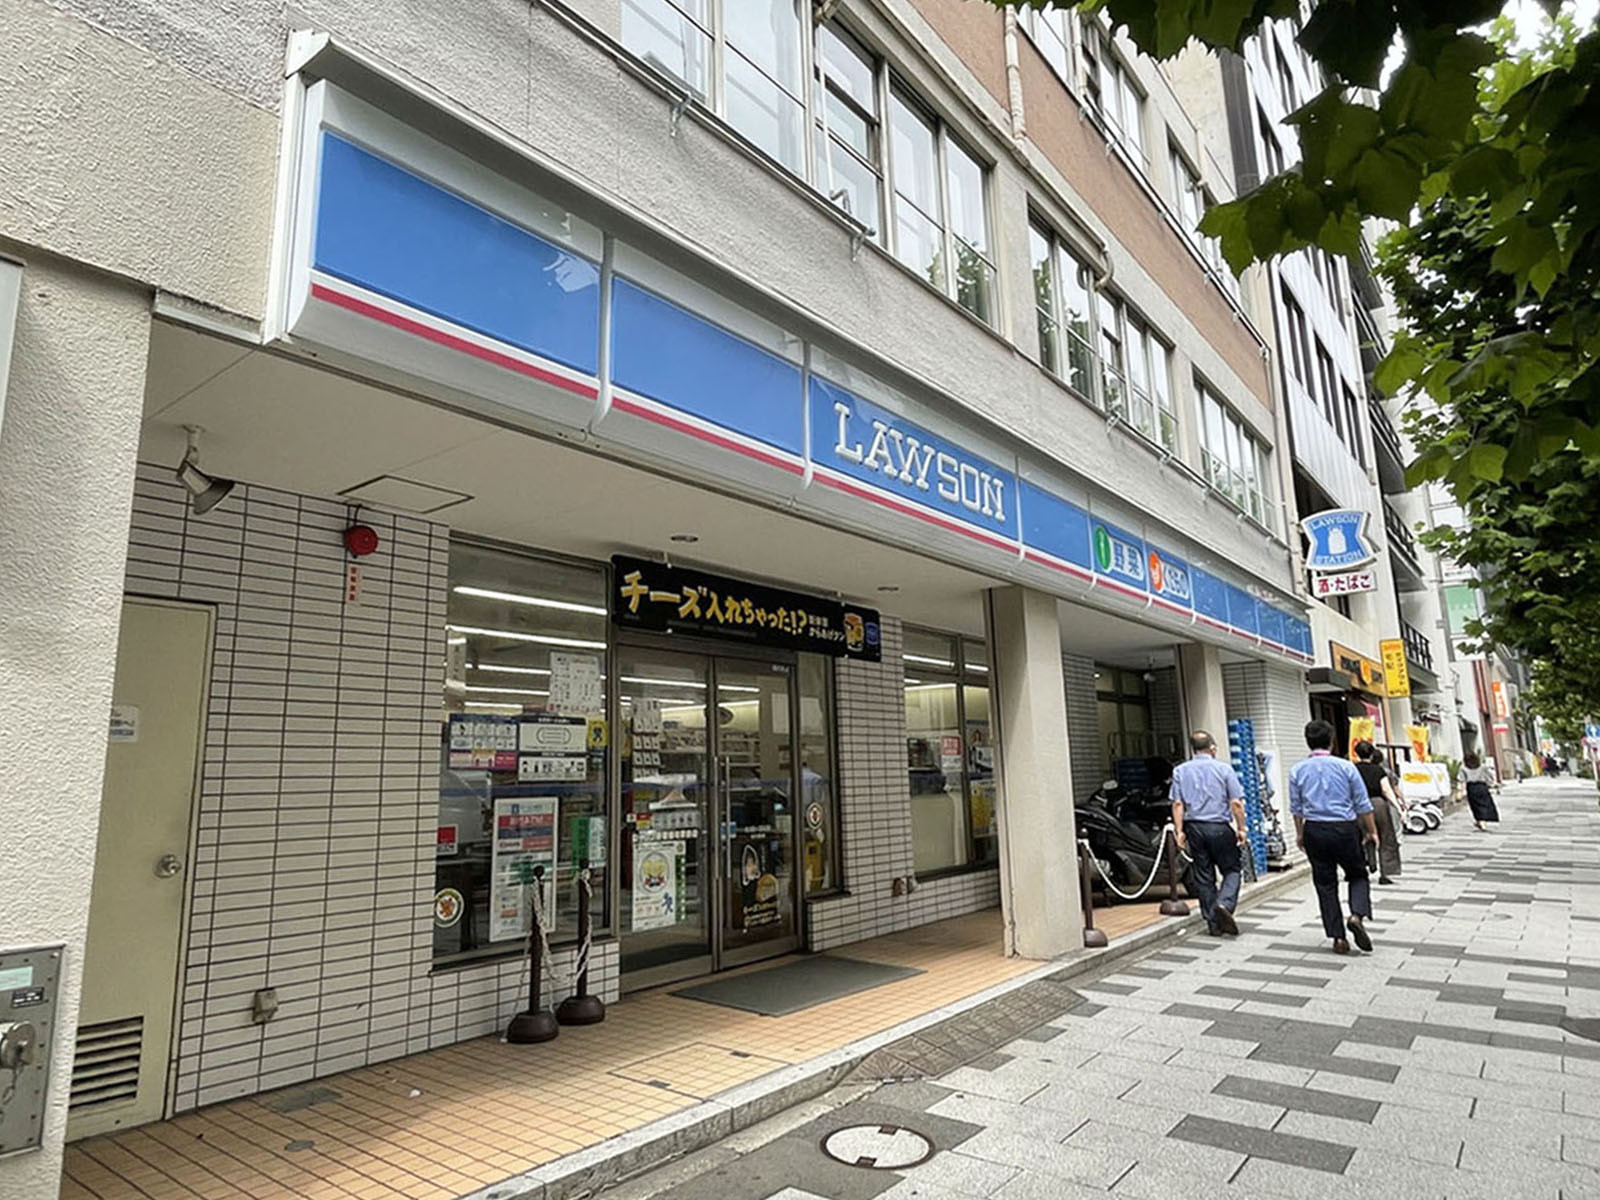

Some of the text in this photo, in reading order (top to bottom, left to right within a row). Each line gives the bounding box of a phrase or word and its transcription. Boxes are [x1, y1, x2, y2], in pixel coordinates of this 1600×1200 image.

[834, 402, 1006, 521] LAWSON
[1311, 514, 1359, 531] LAWSON
[1113, 541, 1140, 577] 野菜
[1315, 548, 1366, 565] STATION
[1319, 574, 1370, 593] 酒・たばこ
